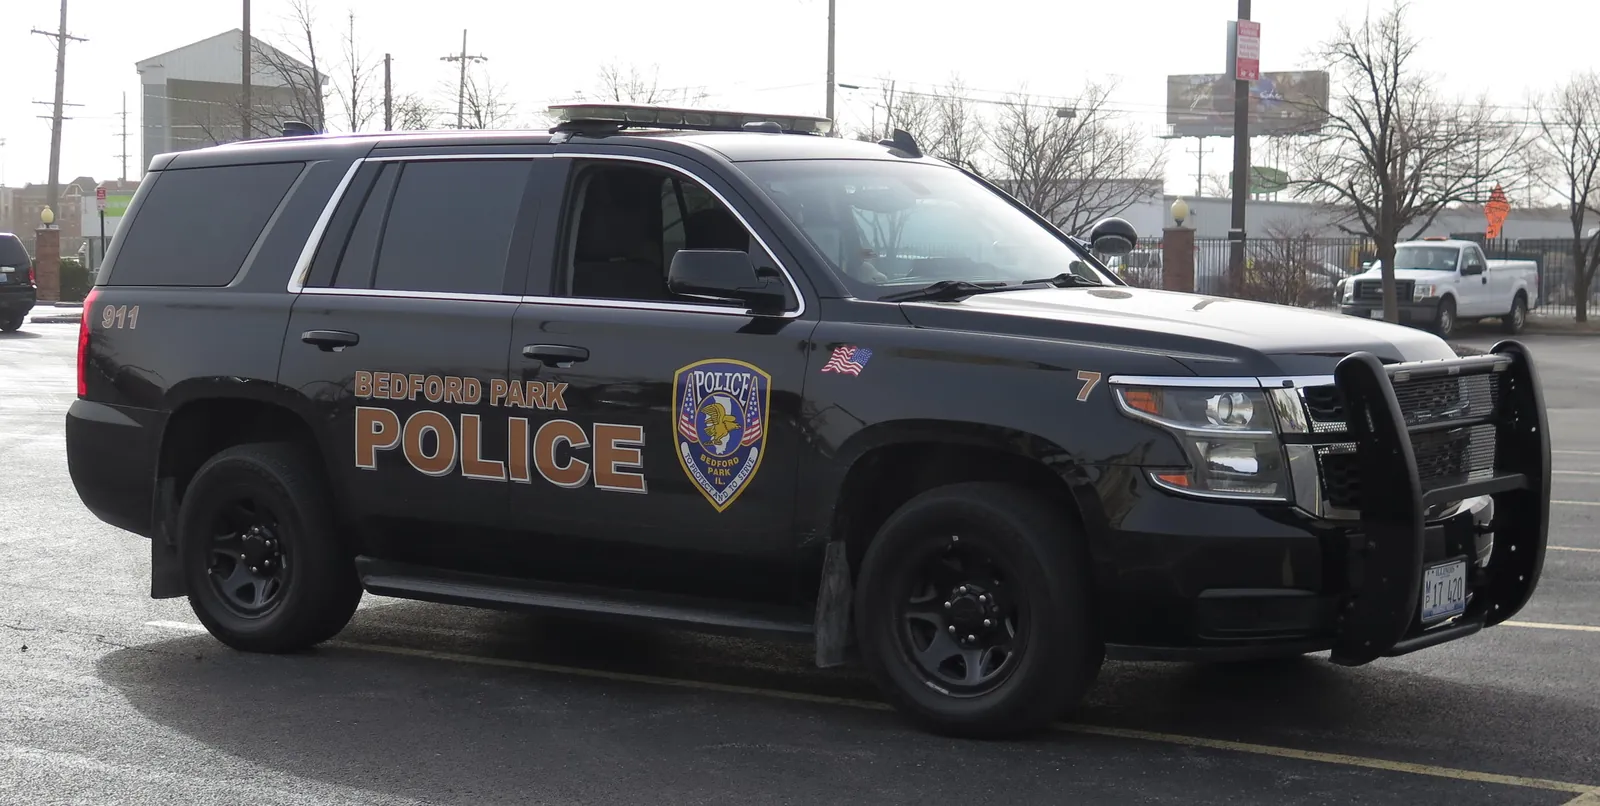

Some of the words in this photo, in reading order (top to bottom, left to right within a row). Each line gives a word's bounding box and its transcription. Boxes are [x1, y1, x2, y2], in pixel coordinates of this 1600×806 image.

[102, 305, 139, 329] 911
[354, 370, 482, 404] BEDFORD
[490, 378, 568, 411] PARK
[694, 371, 751, 407] POLICE
[1076, 370, 1101, 402] 7
[355, 405, 648, 494] POLICE
[700, 454, 740, 468] BEDFORD
[685, 453, 692, 465] TO
[689, 464, 714, 493] PROTECT
[713, 491, 729, 502] AND
[730, 481, 738, 491] TO
[739, 457, 755, 480] SERVE
[707, 467, 731, 476] PARK
[1433, 581, 1443, 607] 17
[1448, 577, 1463, 603] 420
